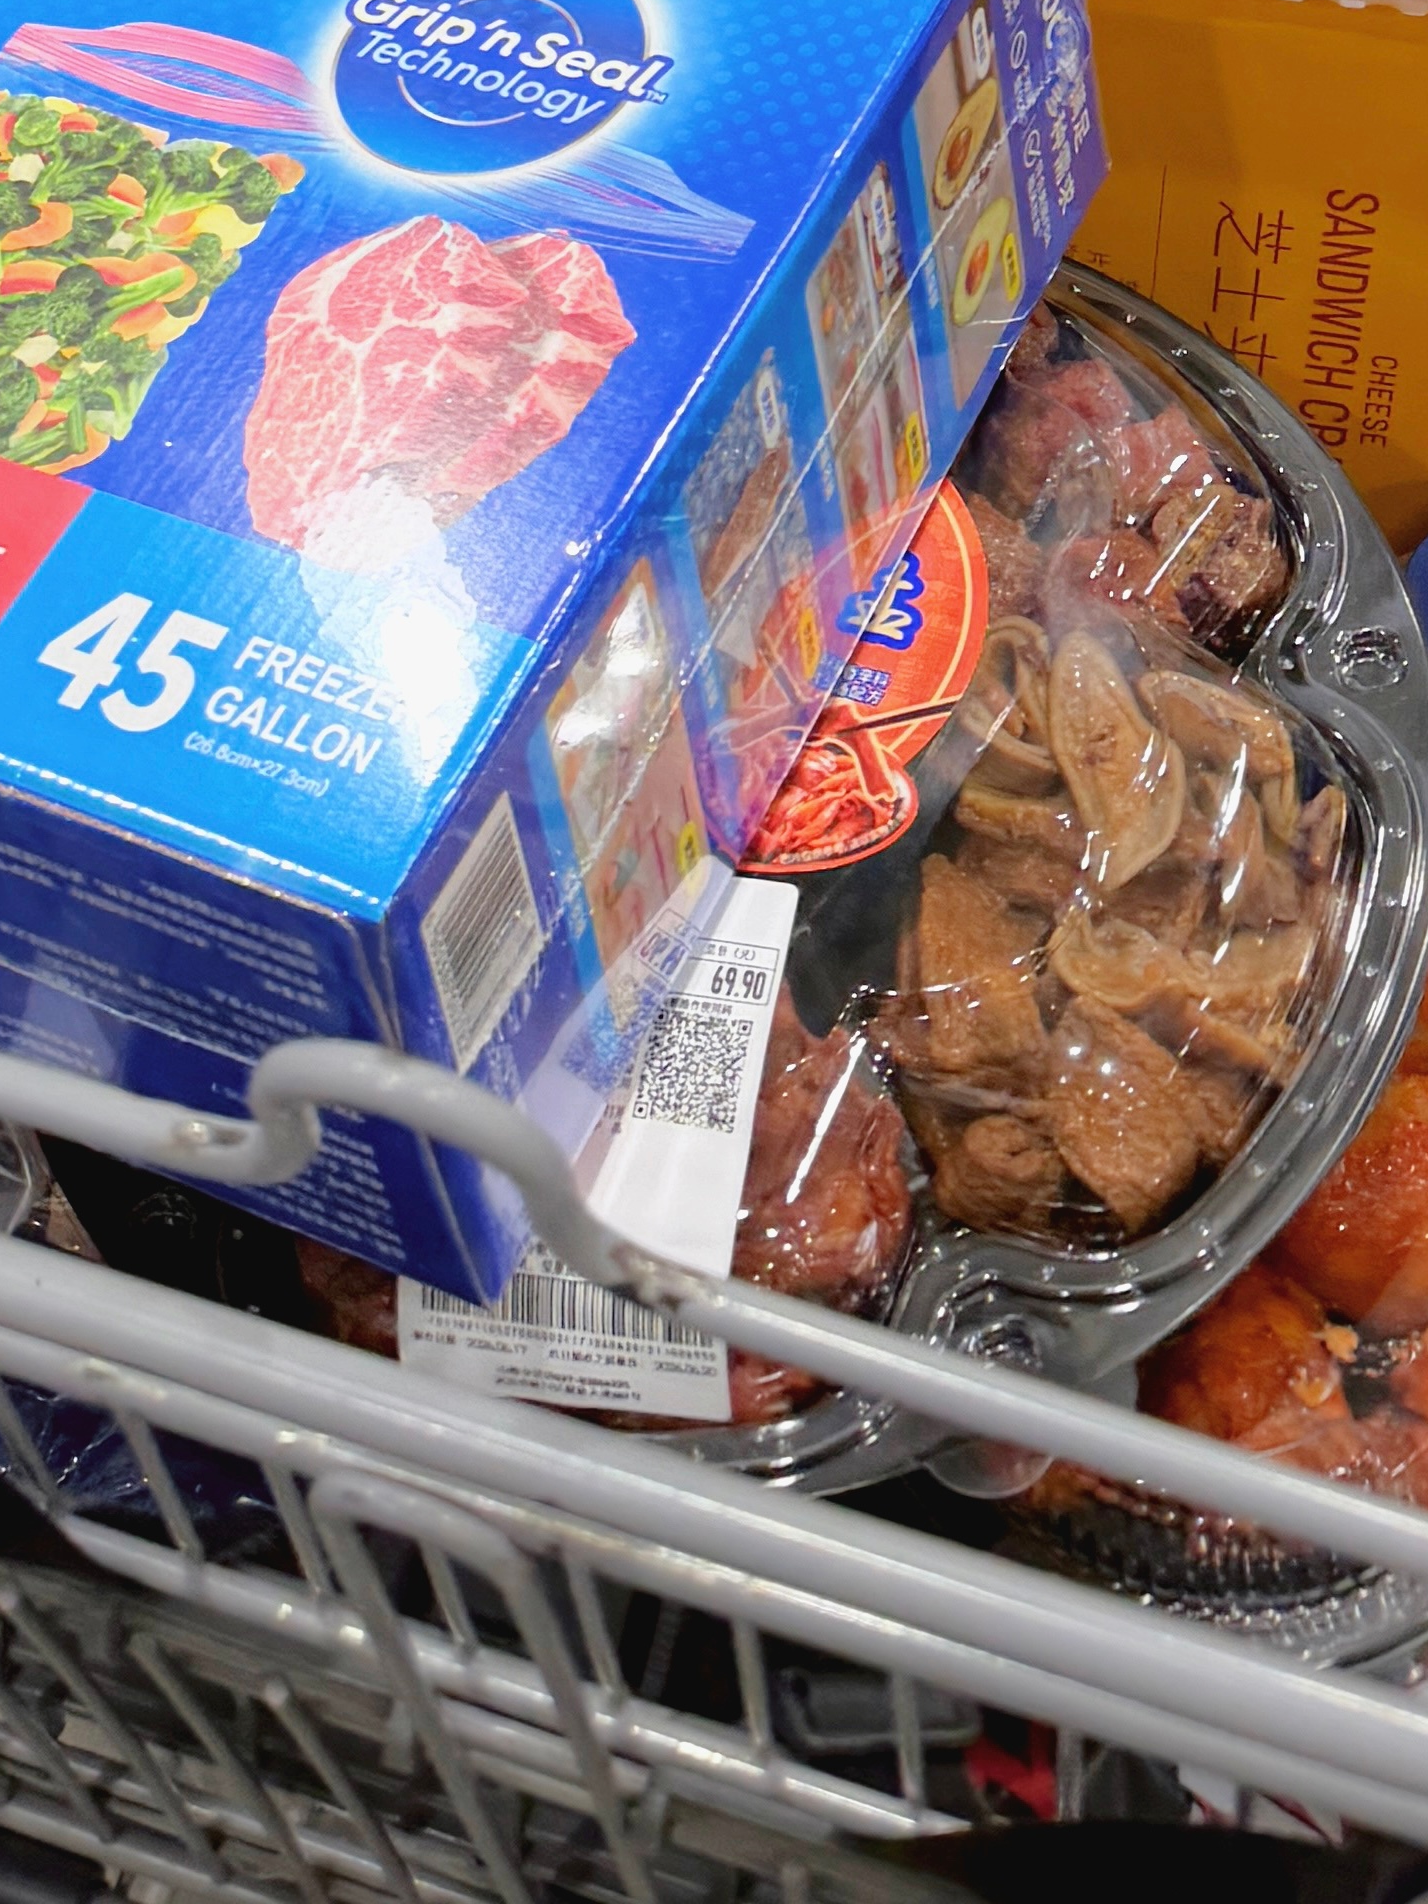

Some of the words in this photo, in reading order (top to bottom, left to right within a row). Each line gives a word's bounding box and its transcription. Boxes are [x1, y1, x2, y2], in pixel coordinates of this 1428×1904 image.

[357, 30, 606, 124] Technology
[518, 32, 671, 97] Seal
[1302, 189, 1380, 392] SANDWICH
[1360, 354, 1398, 449] CHEESE
[37, 591, 230, 733] 45
[204, 685, 384, 774] GALLON
[710, 963, 769, 1001] 69.90
